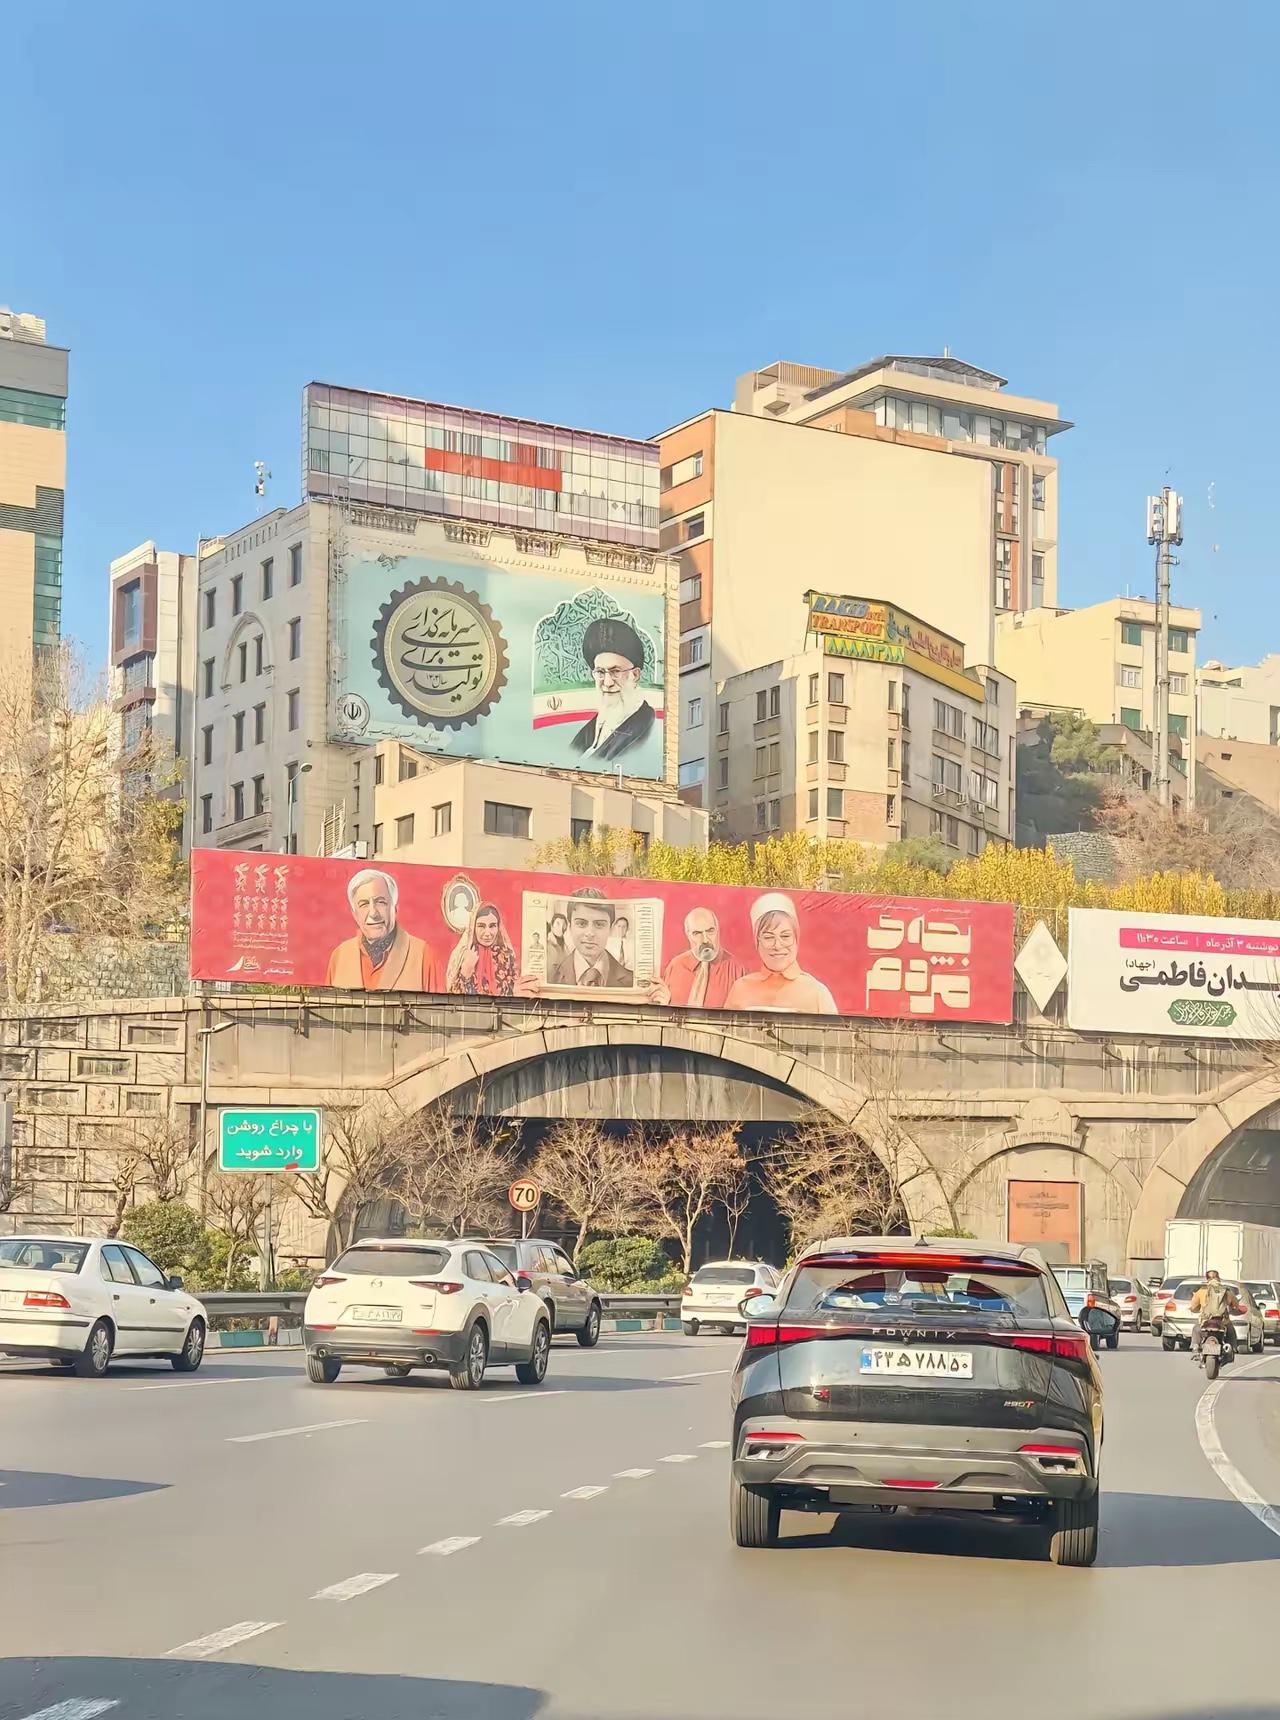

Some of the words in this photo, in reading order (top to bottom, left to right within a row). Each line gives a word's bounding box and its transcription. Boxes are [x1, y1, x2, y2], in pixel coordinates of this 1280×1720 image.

[1160, 934, 1188, 945] ساعت
[1125, 959, 1156, 972] (جهاد)
[1119, 961, 1207, 992] فاطمی
[866, 957, 971, 1014] مردم
[227, 1120, 265, 1135] روشن
[269, 1120, 300, 1136] چراغ
[235, 1145, 273, 1161] شوید
[276, 1145, 303, 1160] وارد
[515, 1187, 535, 1203] 70
